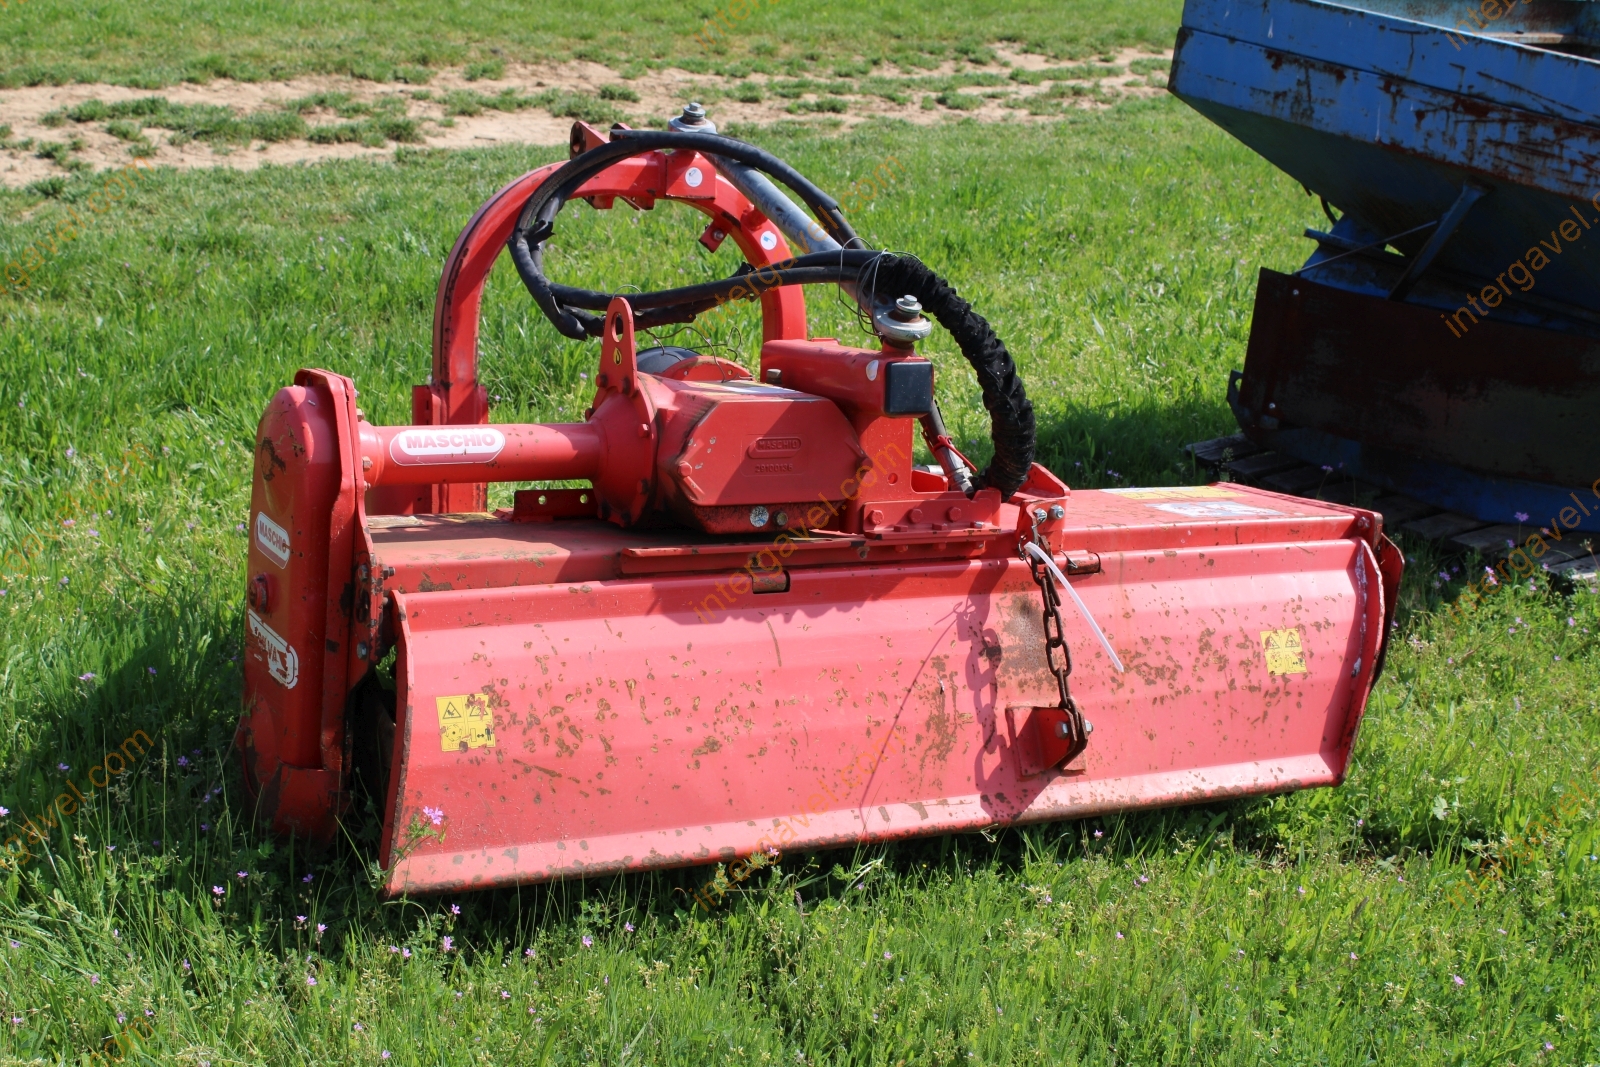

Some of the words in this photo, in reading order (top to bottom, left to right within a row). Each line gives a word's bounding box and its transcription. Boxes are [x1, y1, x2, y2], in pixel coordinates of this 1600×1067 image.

[405, 433, 496, 449] MASCHIO
[758, 440, 798, 450] MASCHIO
[259, 520, 287, 554] MASCHIO
